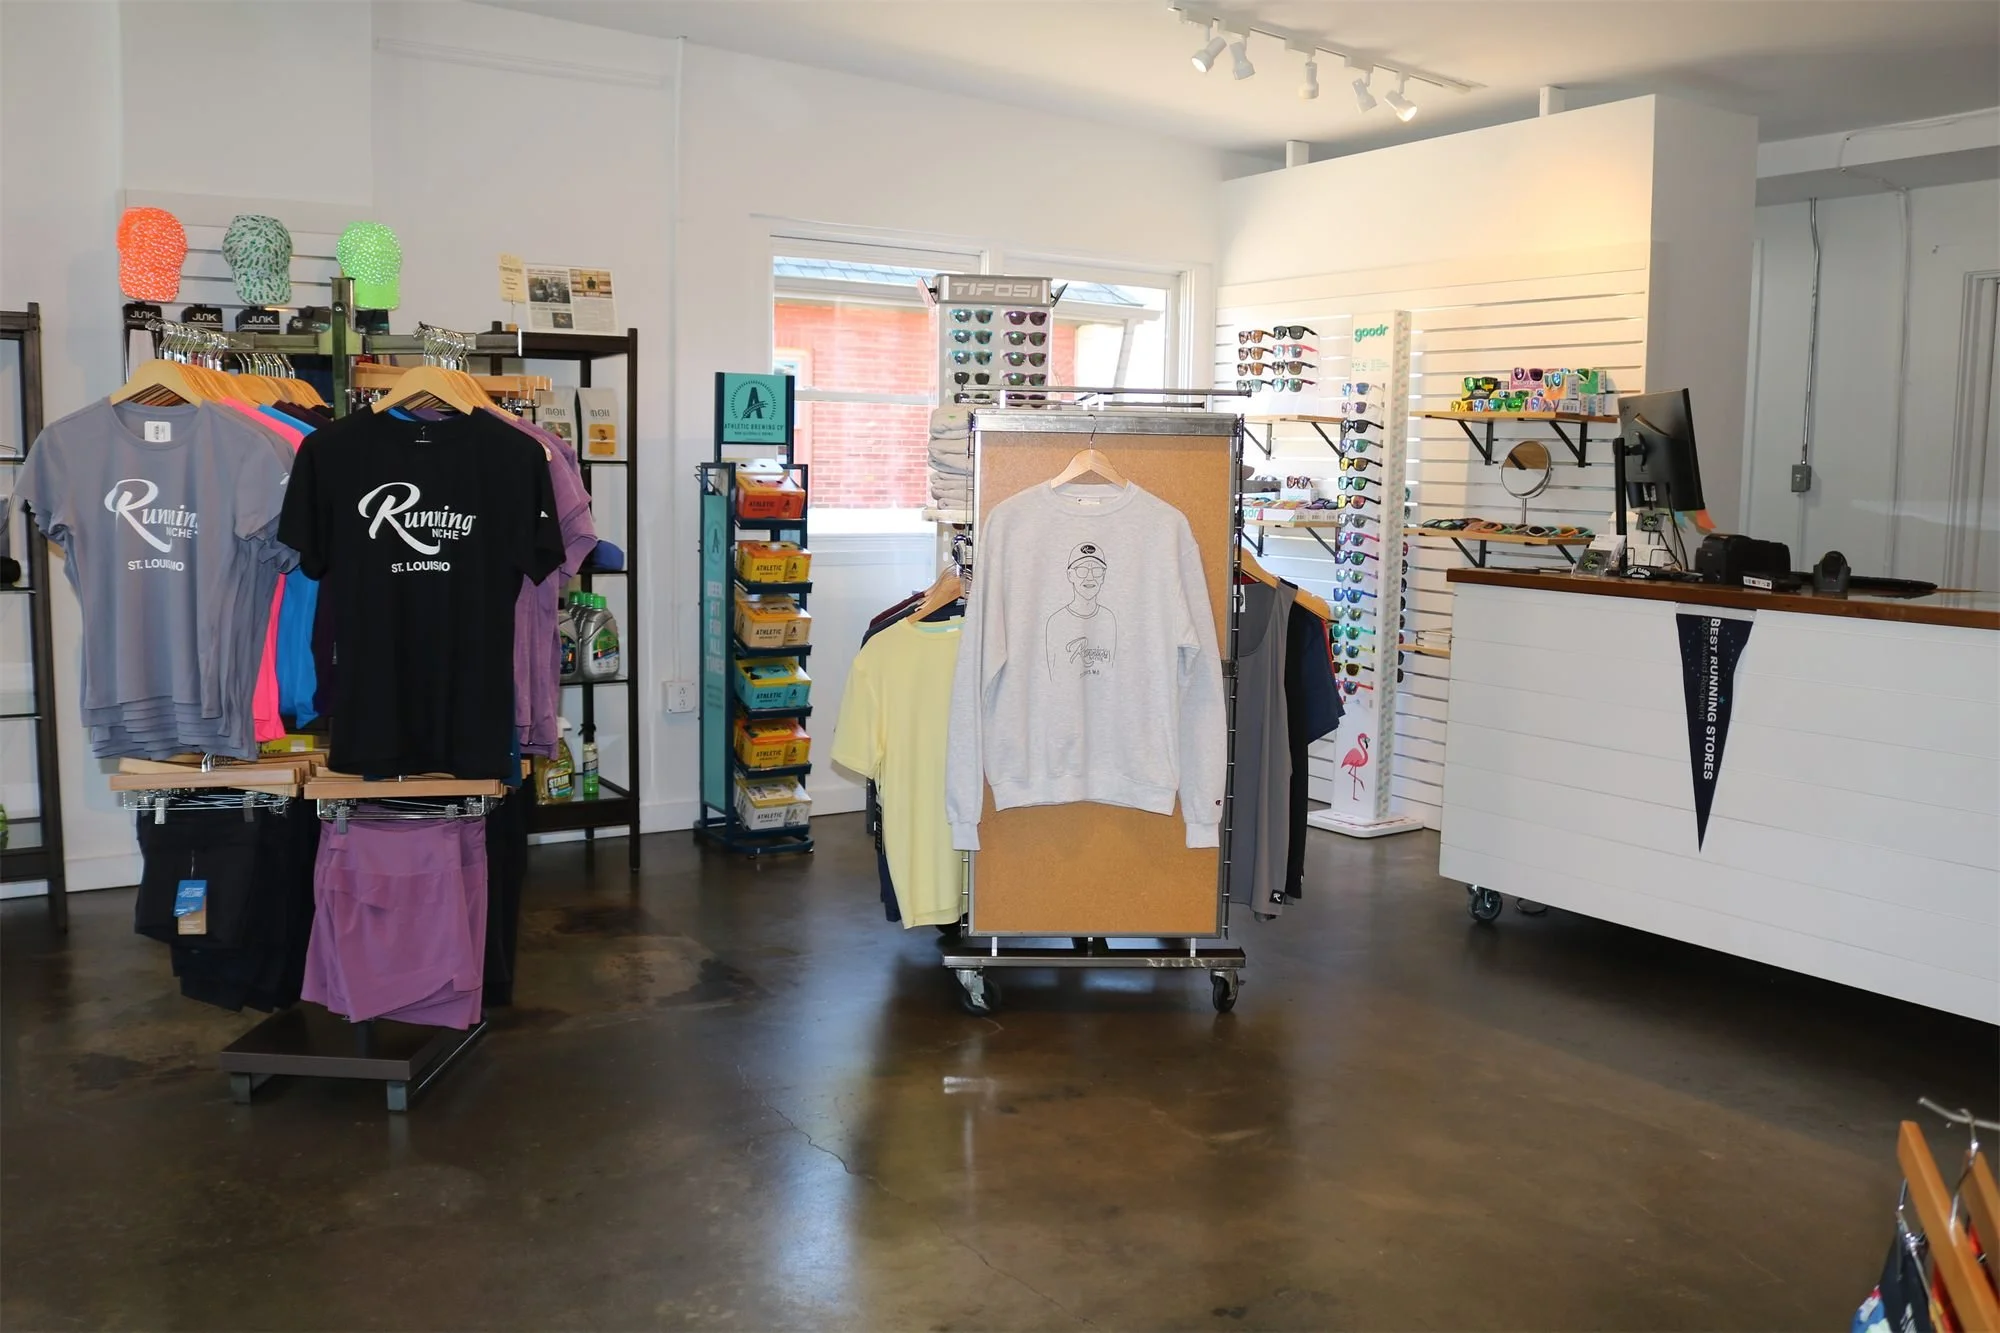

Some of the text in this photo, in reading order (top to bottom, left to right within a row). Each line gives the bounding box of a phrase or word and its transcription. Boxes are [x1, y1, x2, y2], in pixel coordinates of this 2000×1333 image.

[951, 282, 1040, 298] TIFOSI
[192, 312, 217, 322] JUNK
[247, 313, 274, 323] JUNK
[1354, 323, 1389, 343] goodr
[391, 562, 404, 573] ST.
[1698, 675, 1708, 720] Recipient
[1703, 617, 1721, 780] BEST RUNNING STORES
